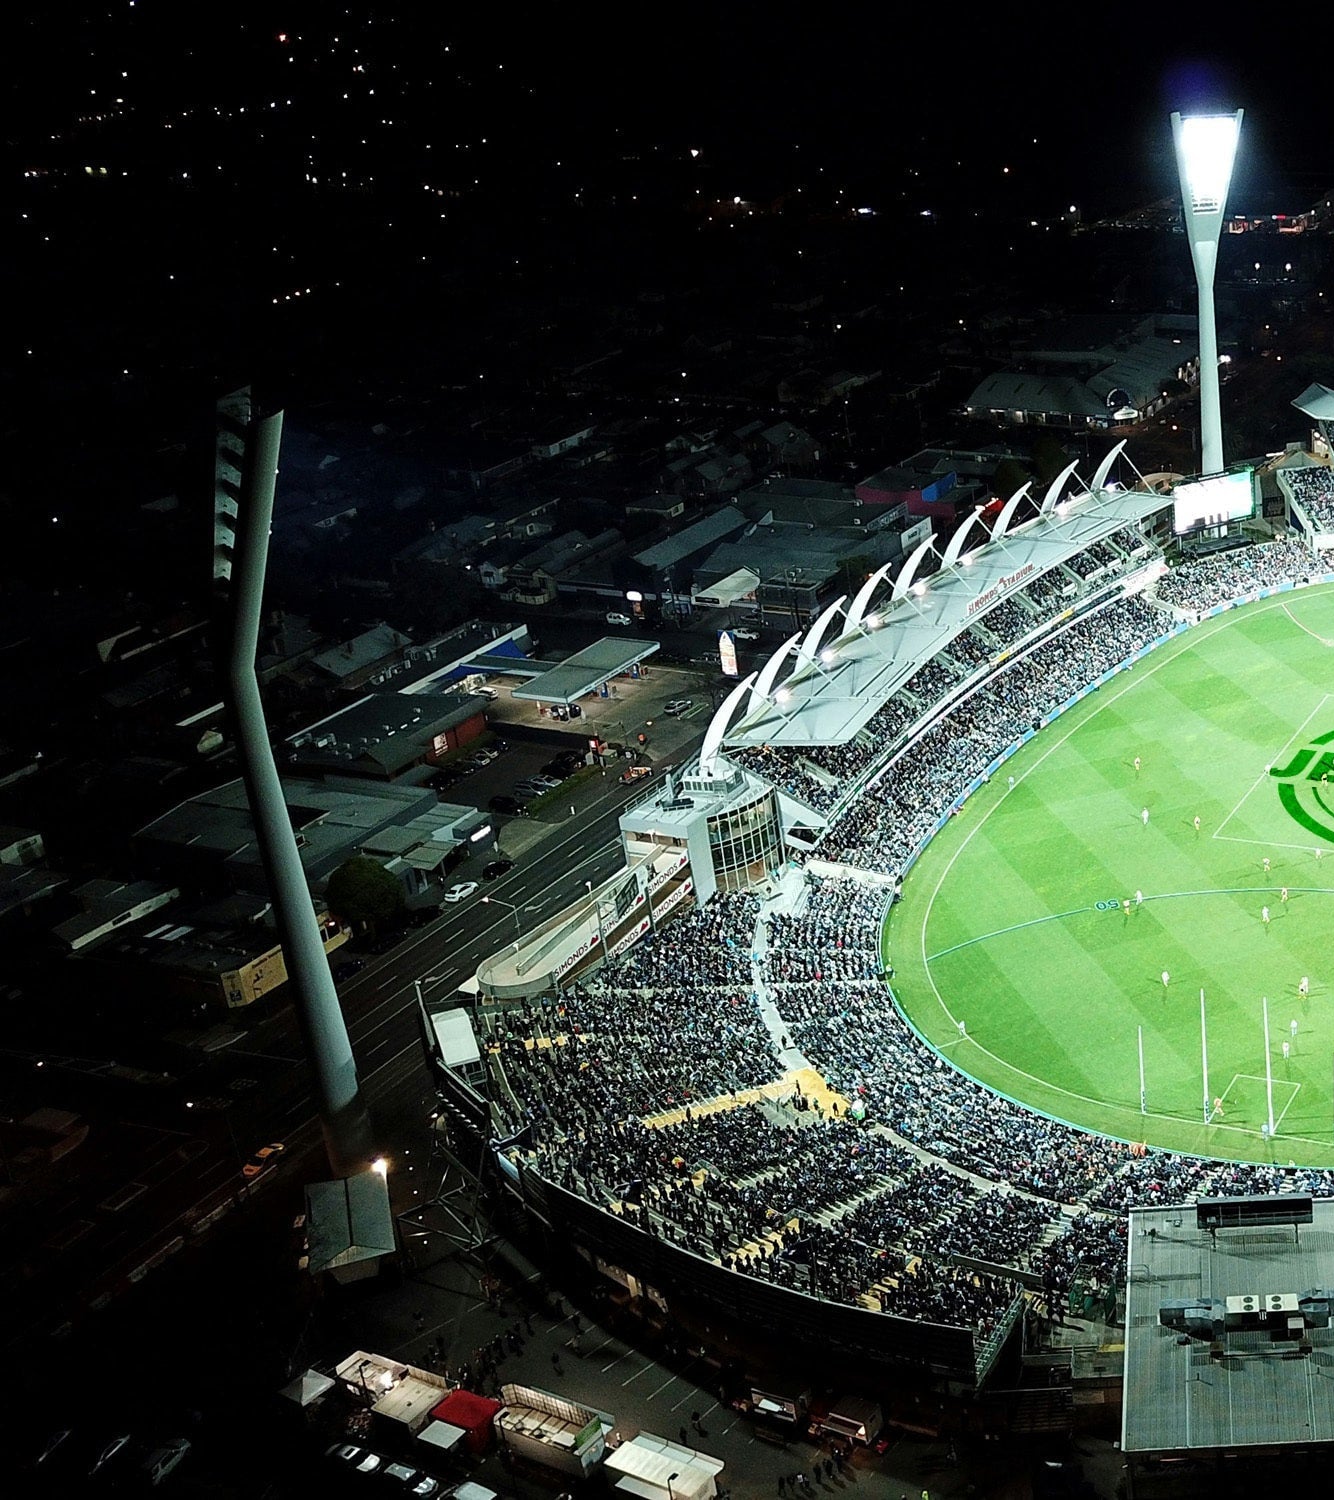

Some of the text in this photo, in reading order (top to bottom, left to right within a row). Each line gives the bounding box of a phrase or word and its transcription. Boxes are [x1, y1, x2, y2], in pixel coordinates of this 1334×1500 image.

[648, 863, 679, 895] SIMONDS
[652, 890, 683, 921] SIMONDS
[554, 942, 589, 977] SIMONDS
[608, 929, 640, 960] SIMONDS
